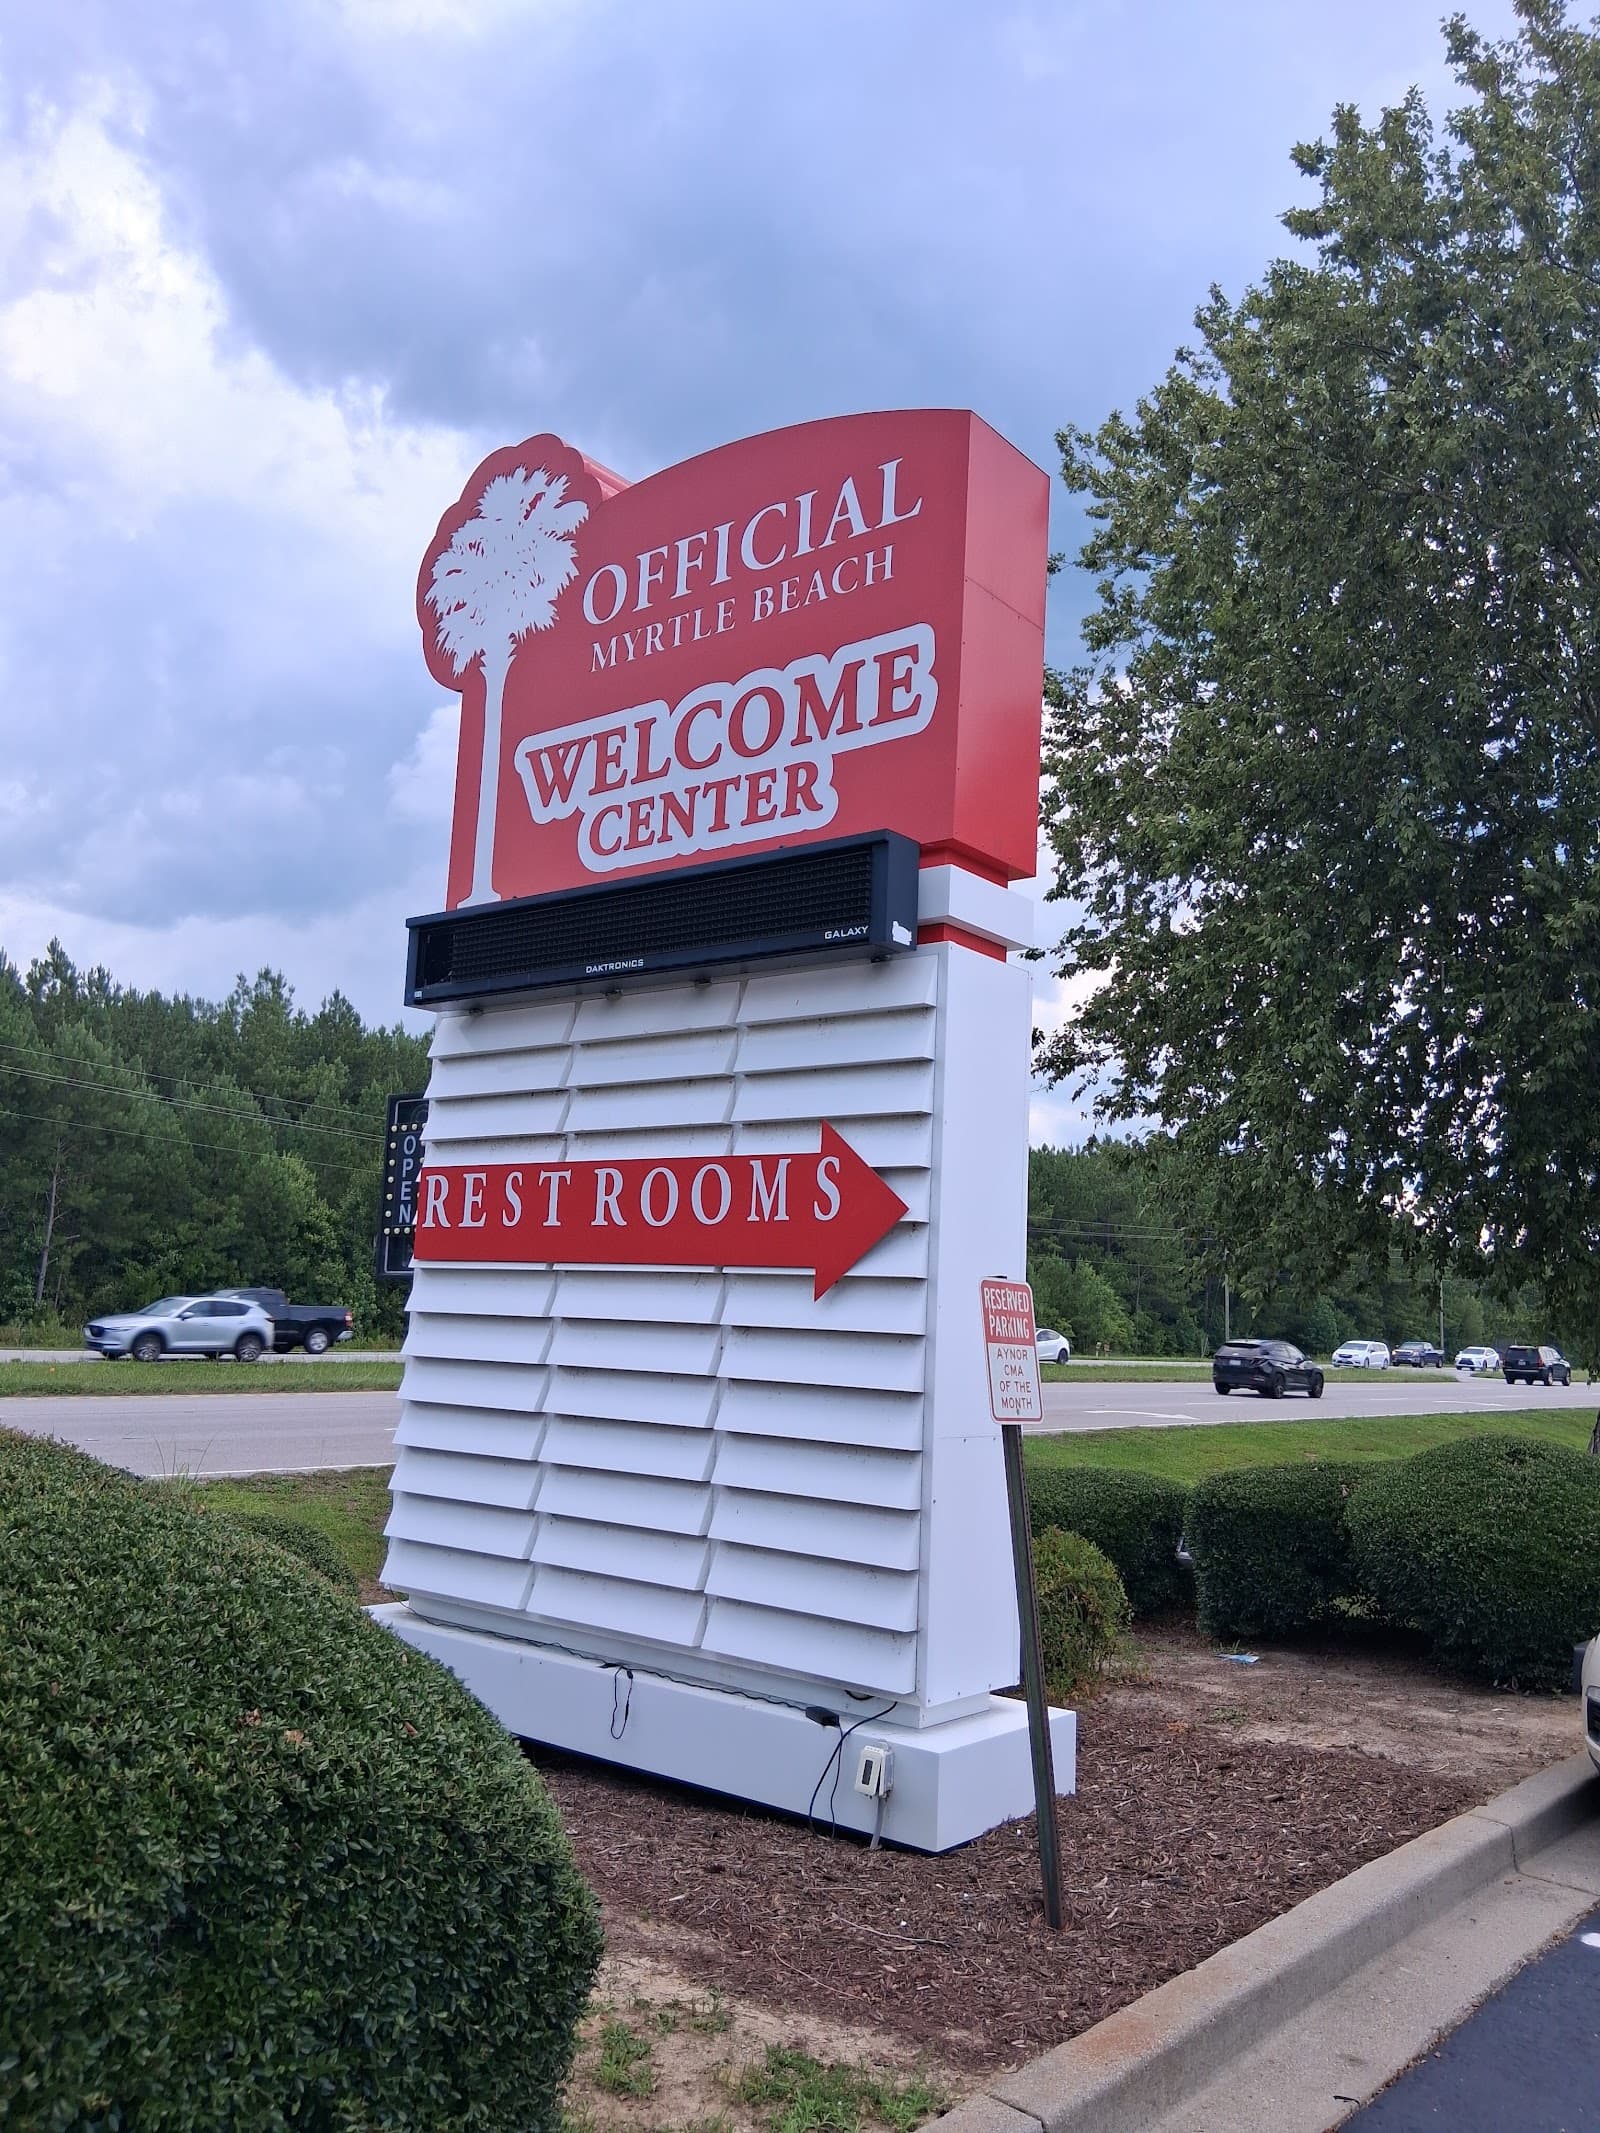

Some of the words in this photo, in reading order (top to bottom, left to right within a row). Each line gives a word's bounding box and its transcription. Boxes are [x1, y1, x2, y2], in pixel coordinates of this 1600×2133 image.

[582, 457, 923, 626] OFFICIAL
[590, 599, 737, 673] MYRTLE
[752, 545, 895, 623] BEACH
[525, 643, 923, 808] WELCOME
[589, 760, 823, 856] CENTER
[824, 925, 869, 940] GALAXY
[585, 958, 645, 974] DAKTRONICS
[398, 1134, 417, 1225] OPEN
[983, 1287, 1030, 1313] RESERVED
[988, 1314, 1030, 1339] PARKING
[996, 1349, 1029, 1361] AYNOR
[1004, 1364, 1024, 1377] CMA
[999, 1380, 1011, 1393] OF
[1014, 1381, 1032, 1393] THE
[1001, 1397, 1033, 1410] MONTH
